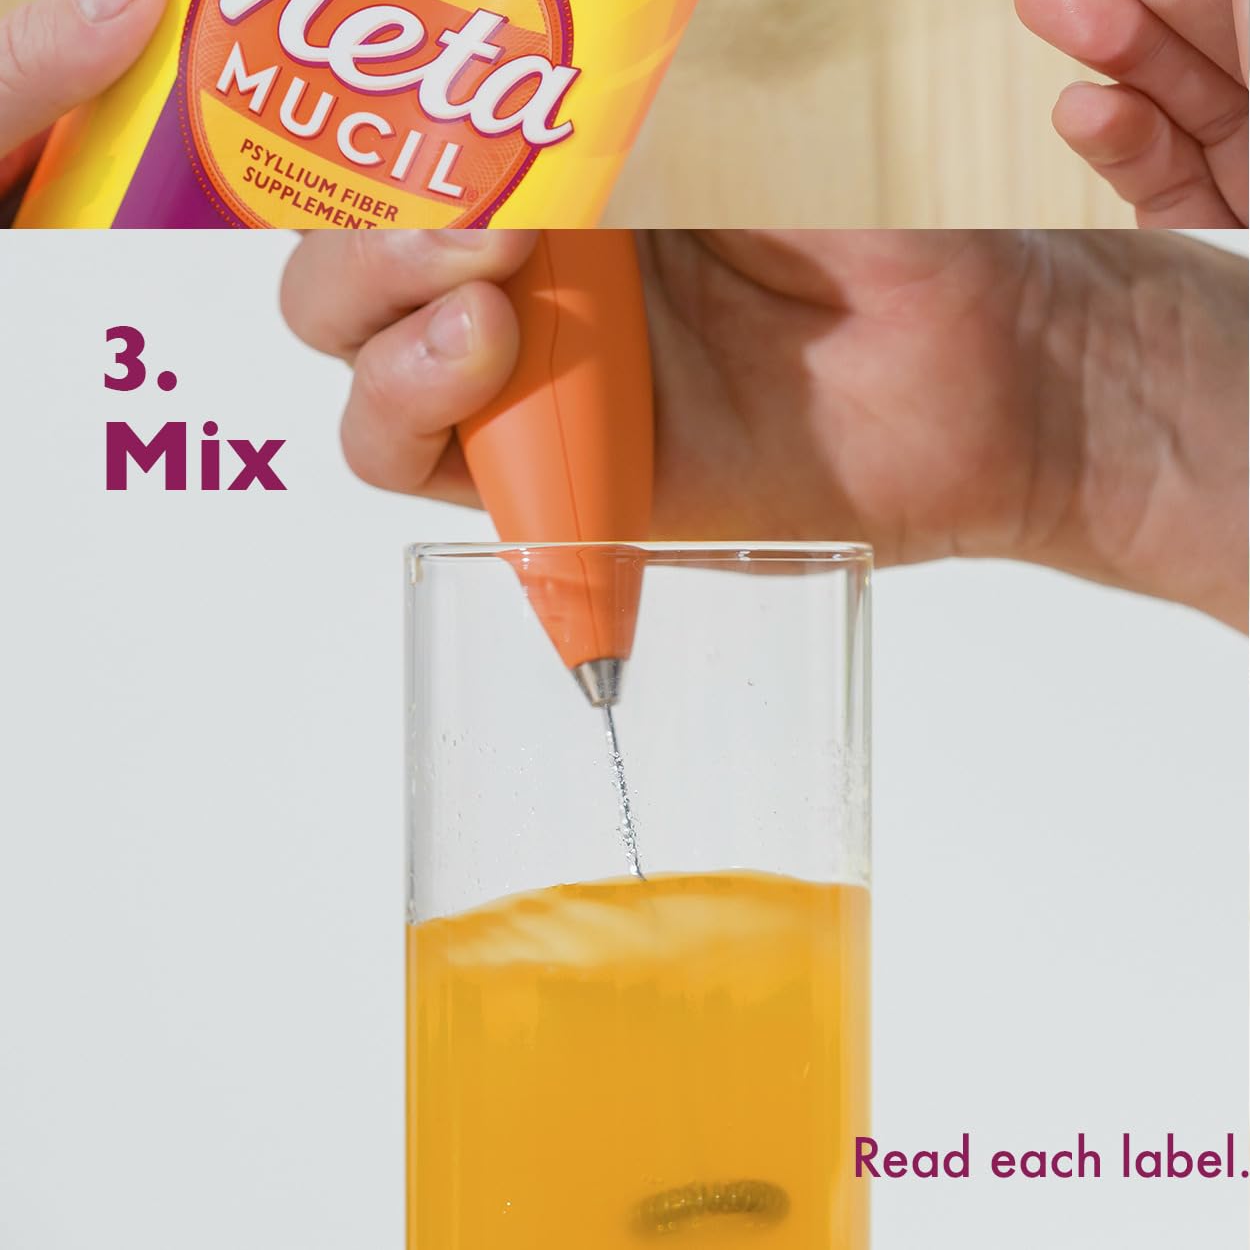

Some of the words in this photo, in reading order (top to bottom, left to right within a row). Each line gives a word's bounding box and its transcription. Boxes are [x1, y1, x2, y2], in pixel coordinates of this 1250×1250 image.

[215, 41, 467, 198] MUCIL
[239, 138, 338, 198] PSYLLIUM
[340, 188, 399, 222] FIBER
